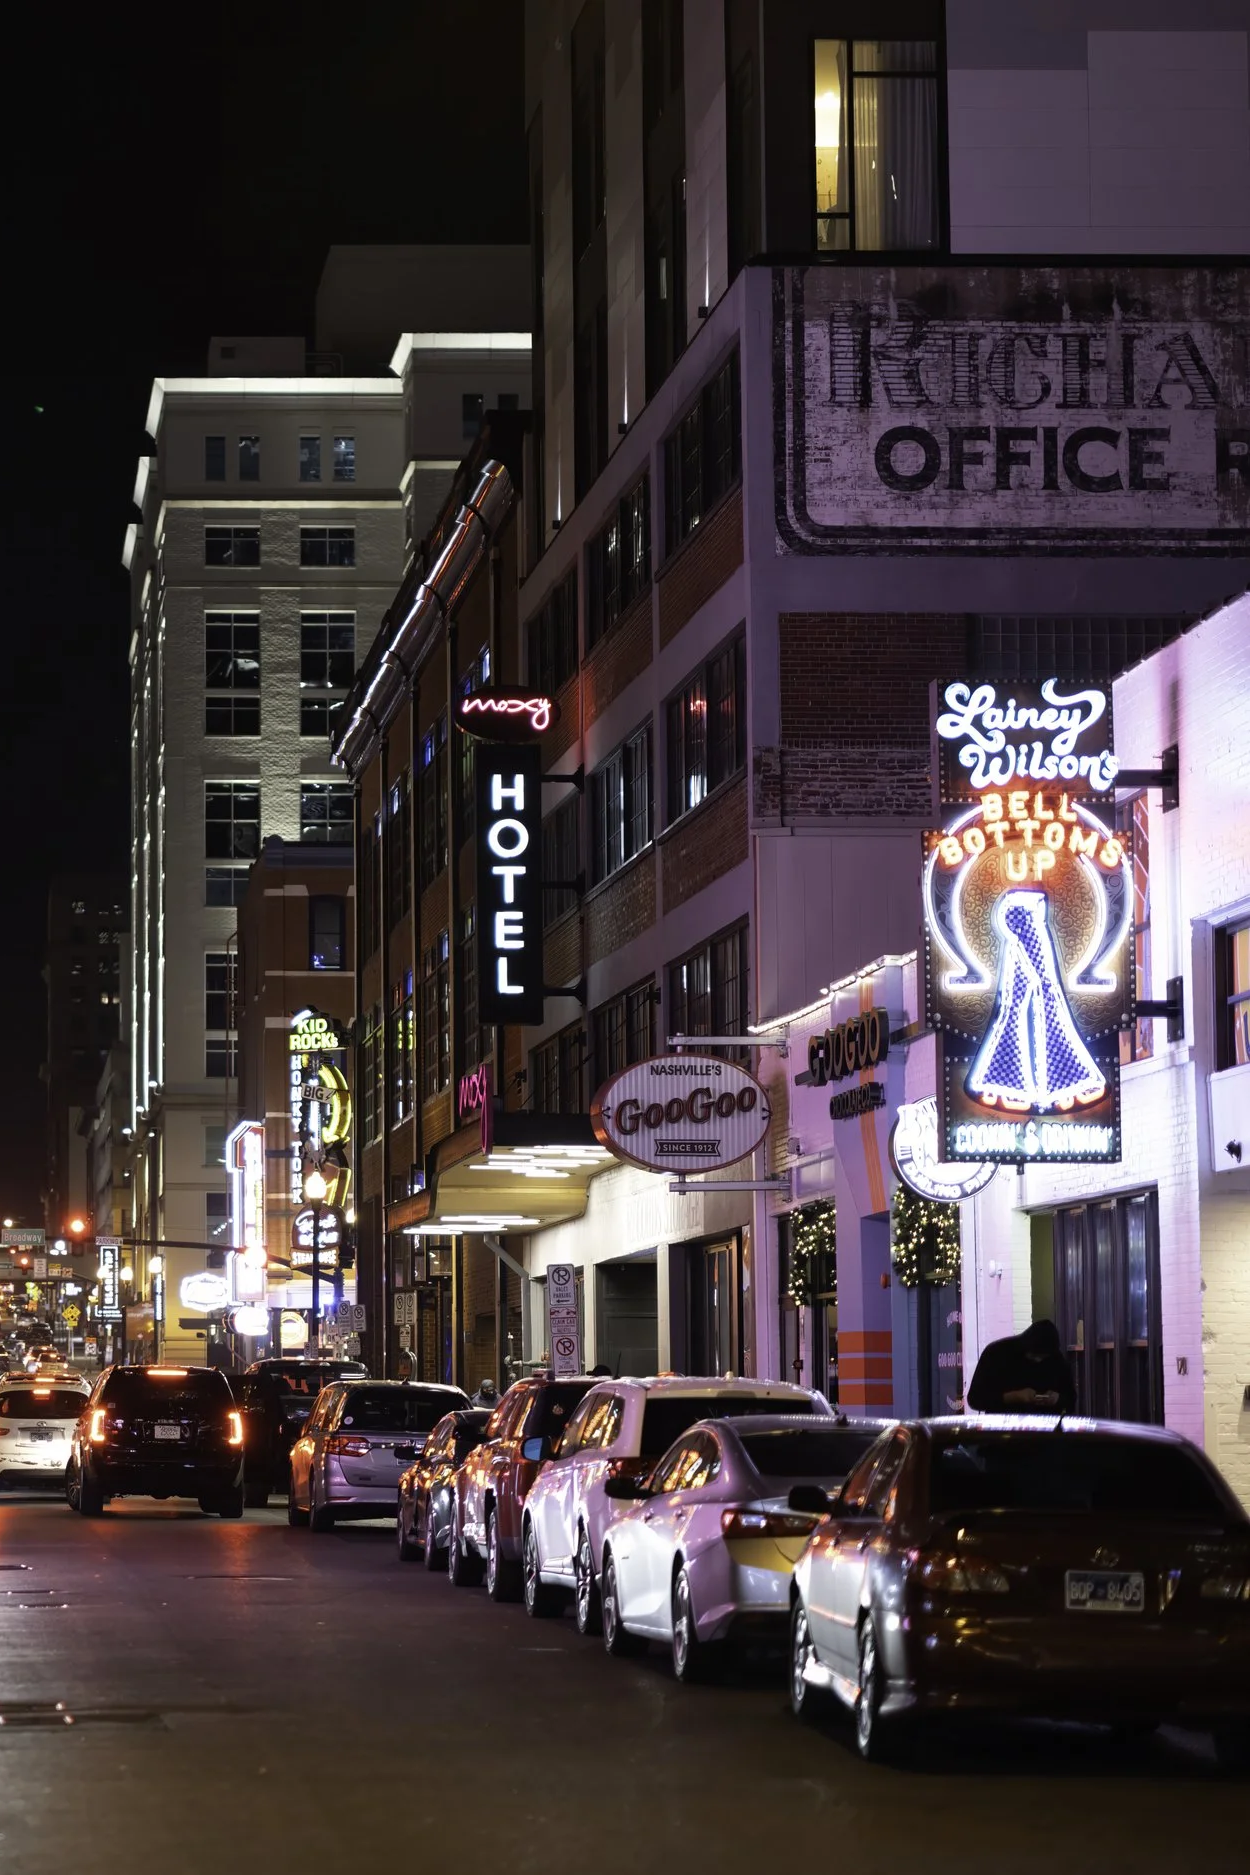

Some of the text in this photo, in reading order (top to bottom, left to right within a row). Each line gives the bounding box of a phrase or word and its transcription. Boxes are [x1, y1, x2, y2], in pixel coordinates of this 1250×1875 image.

[874, 425, 1250, 492] OFFICE R
[462, 698, 551, 730] moxy
[936, 678, 1106, 756] Lainey
[958, 741, 1120, 791] Wilson's
[981, 791, 1077, 821] BELL
[938, 819, 1123, 867] BOTTOMS
[1006, 850, 1056, 881] UP
[488, 774, 529, 994] HOTEL
[297, 1018, 328, 1034] KID
[650, 1064, 721, 1076] NASHVILLE'S
[303, 1085, 325, 1101] BIG
[291, 1054, 303, 1204] HONKY TONK
[955, 1121, 1021, 1153] COOKIN'
[1024, 1119, 1040, 1155] &
[662, 1143, 713, 1152] SINCE 1912
[4, 1232, 43, 1243] Broadway
